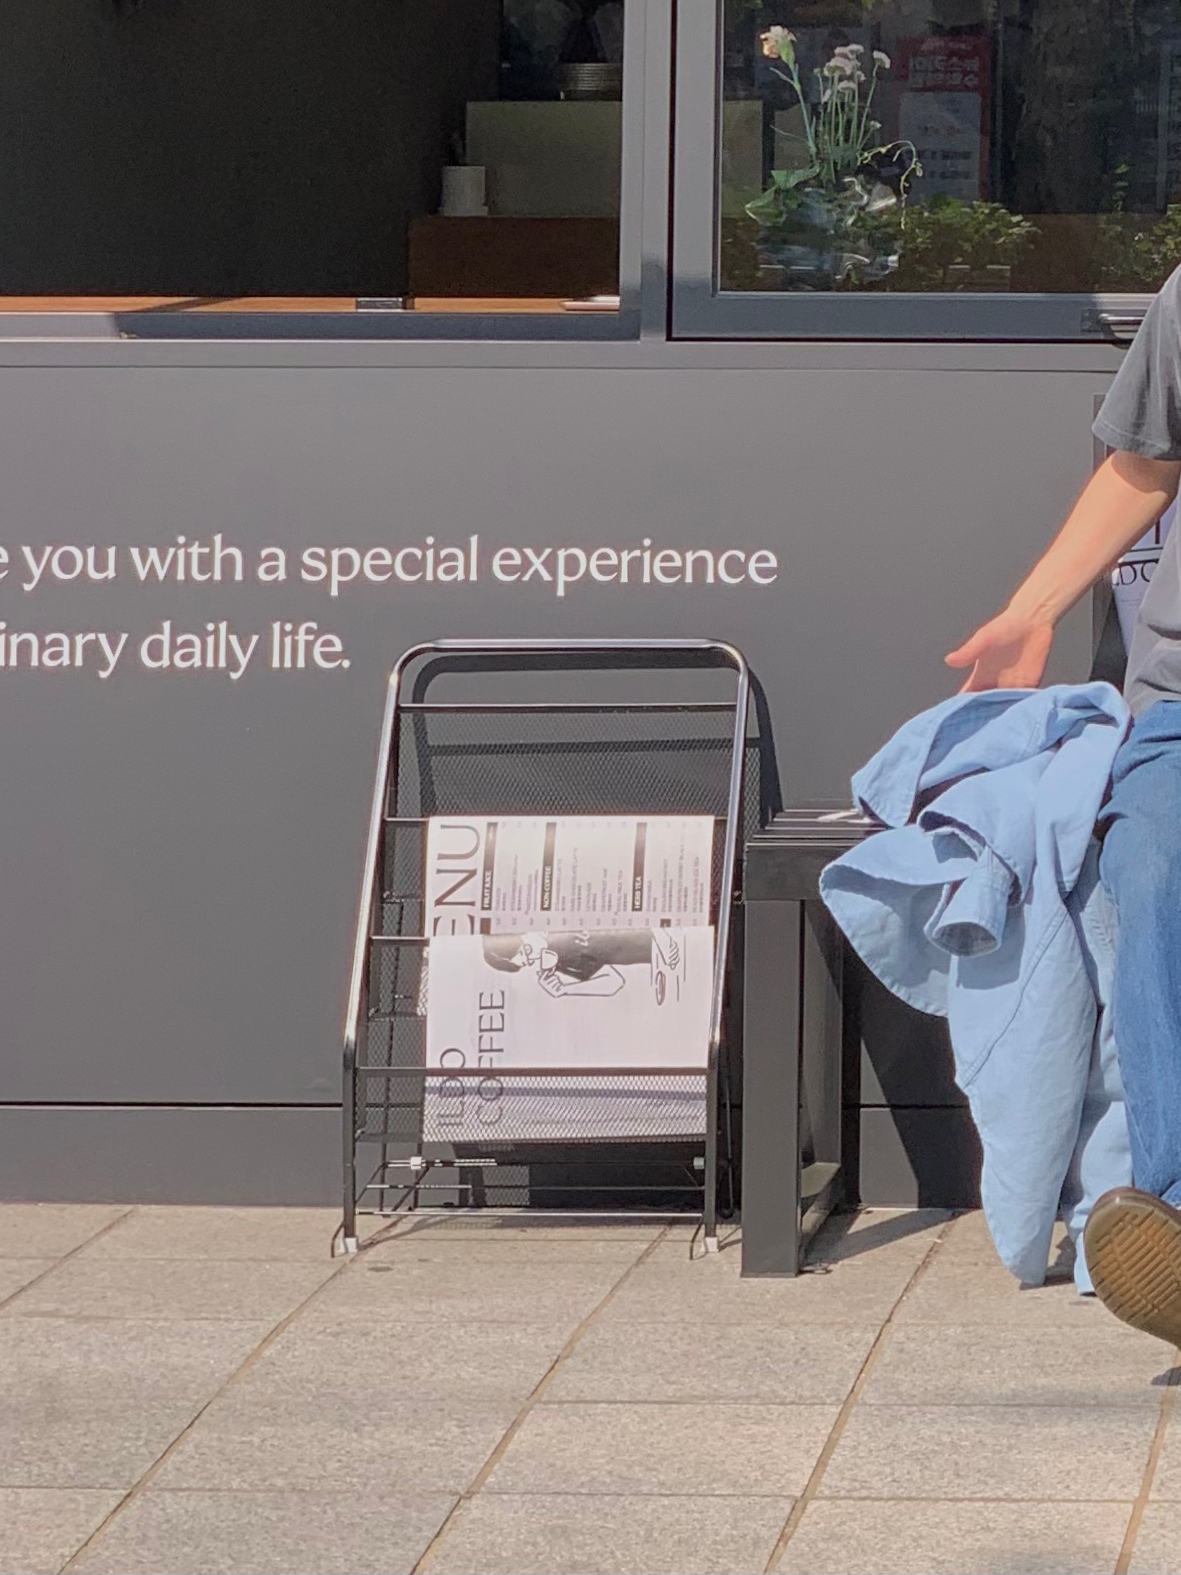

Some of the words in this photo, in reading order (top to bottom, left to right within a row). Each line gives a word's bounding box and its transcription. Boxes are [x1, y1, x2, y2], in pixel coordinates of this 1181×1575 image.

[21, 545, 116, 592] you
[129, 533, 243, 581] with
[257, 546, 288, 581] a
[300, 534, 478, 597] special
[492, 537, 778, 597] experience
[140, 620, 260, 680] daily
[271, 621, 351, 669] life.
[634, 876, 643, 892] TEA
